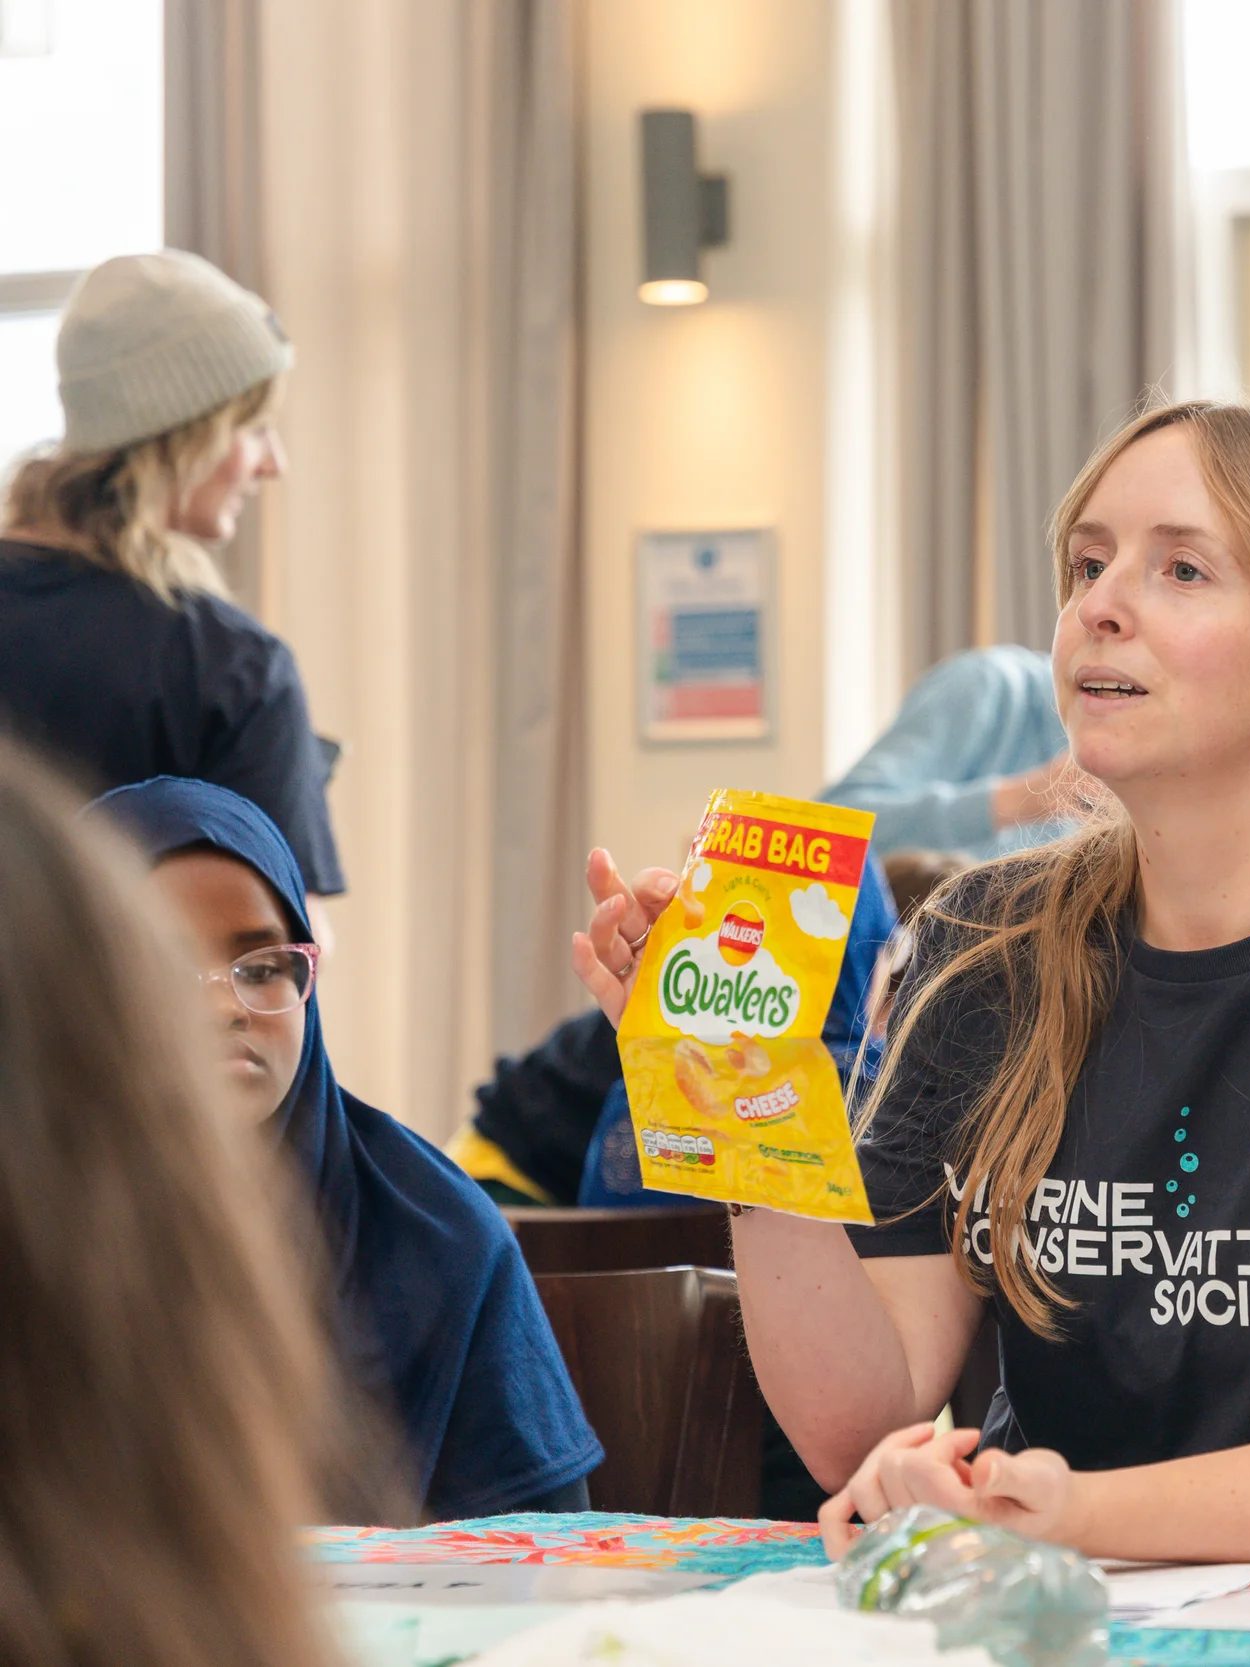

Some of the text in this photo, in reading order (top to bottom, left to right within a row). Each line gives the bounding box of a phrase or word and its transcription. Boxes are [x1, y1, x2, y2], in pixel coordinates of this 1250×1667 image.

[767, 830, 831, 874] BAG
[721, 921, 763, 944] WALKERS
[663, 949, 793, 1027] Quavers
[734, 1080, 800, 1120] CHEESE
